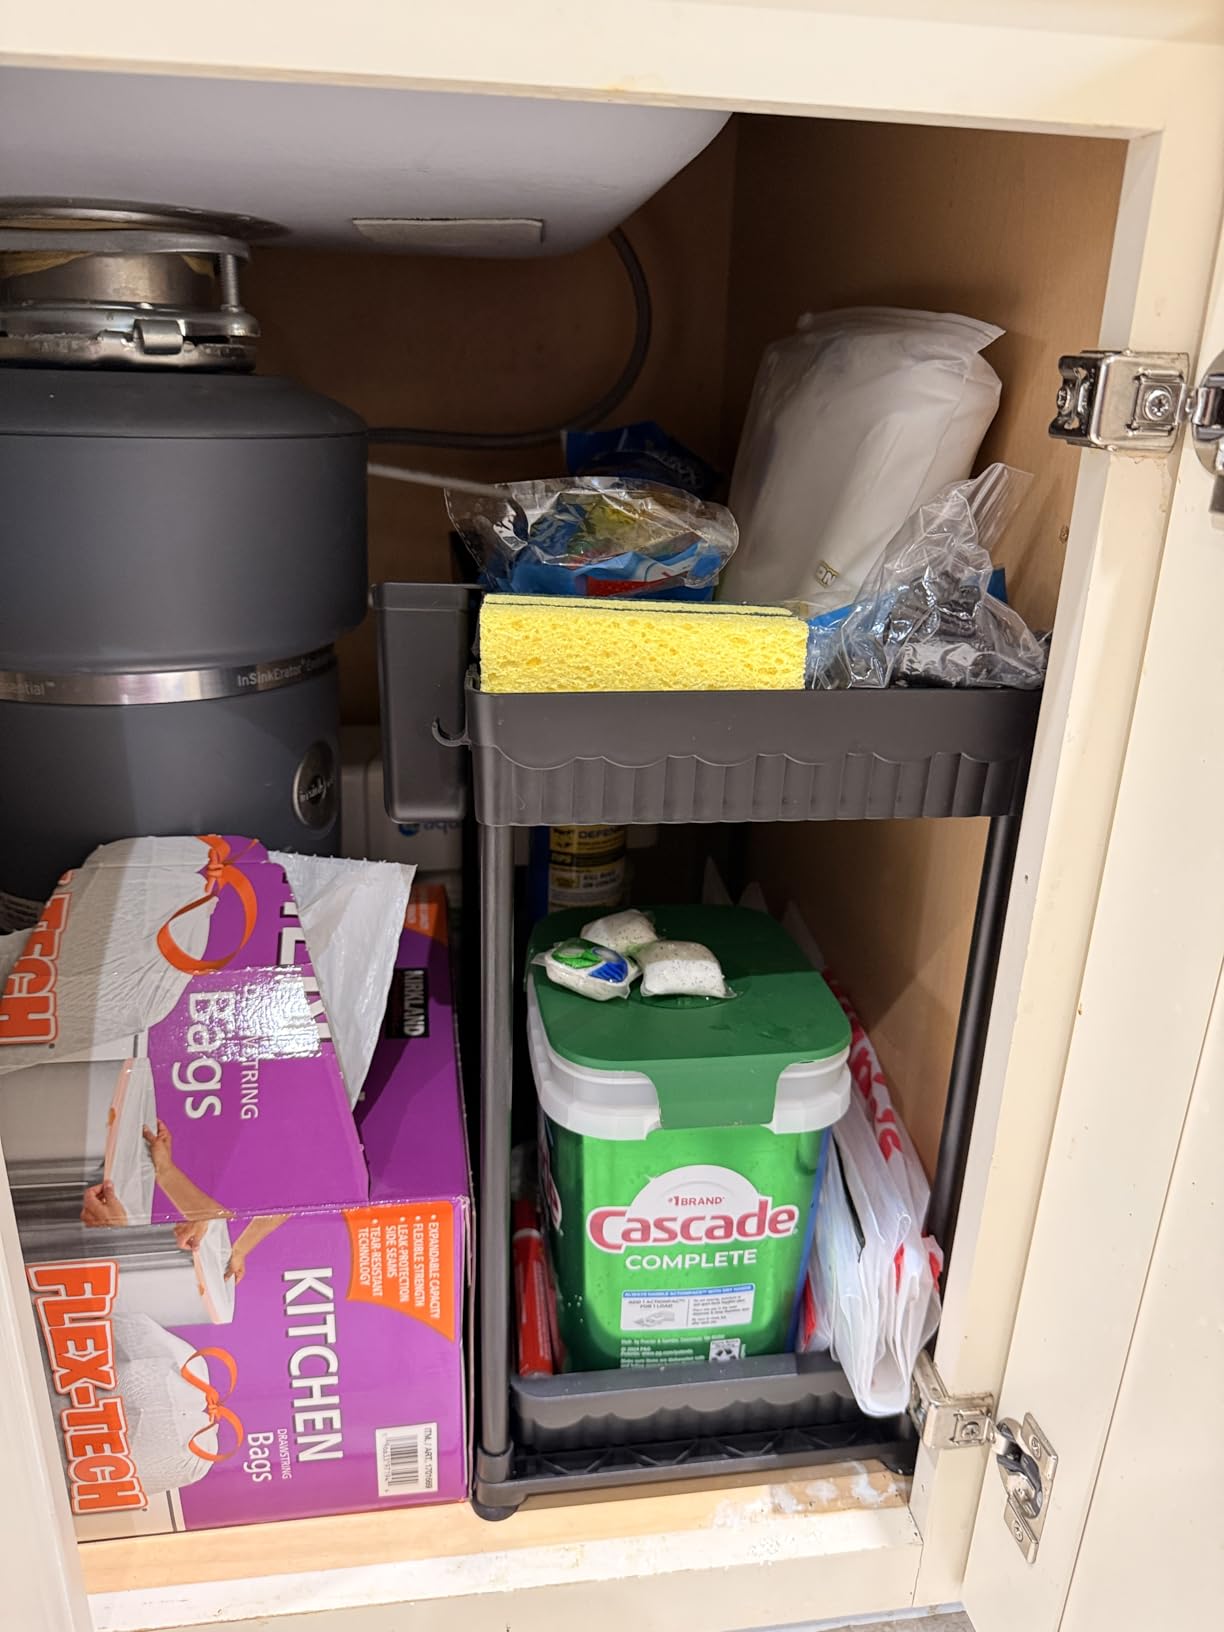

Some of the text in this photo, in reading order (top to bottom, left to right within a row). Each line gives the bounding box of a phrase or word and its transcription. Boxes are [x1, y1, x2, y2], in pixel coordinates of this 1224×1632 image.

[403, 970, 425, 1036] KIRKLAND
[171, 991, 236, 1119] Bags
[588, 1198, 797, 1252] Cascade
[681, 1196, 724, 1206] BRAND
[358, 1227, 371, 1286] TECHNOLOGY
[370, 1226, 383, 1296] TEAR-RESISTANT
[385, 1225, 397, 1278] SIDE SEAMS
[398, 1224, 410, 1302] LEAK-PROTECTION
[413, 1223, 425, 1307] FLEXIBLE STRENGTH
[428, 1221, 441, 1319] EXPANDABLE CAPACITY
[625, 1249, 758, 1270] COMPLETE
[25, 1260, 149, 1514] FLEX-TECH
[283, 1267, 344, 1462] KITCHEN
[243, 1431, 274, 1483] Bags
[277, 1428, 292, 1480] DRAWSTRING
